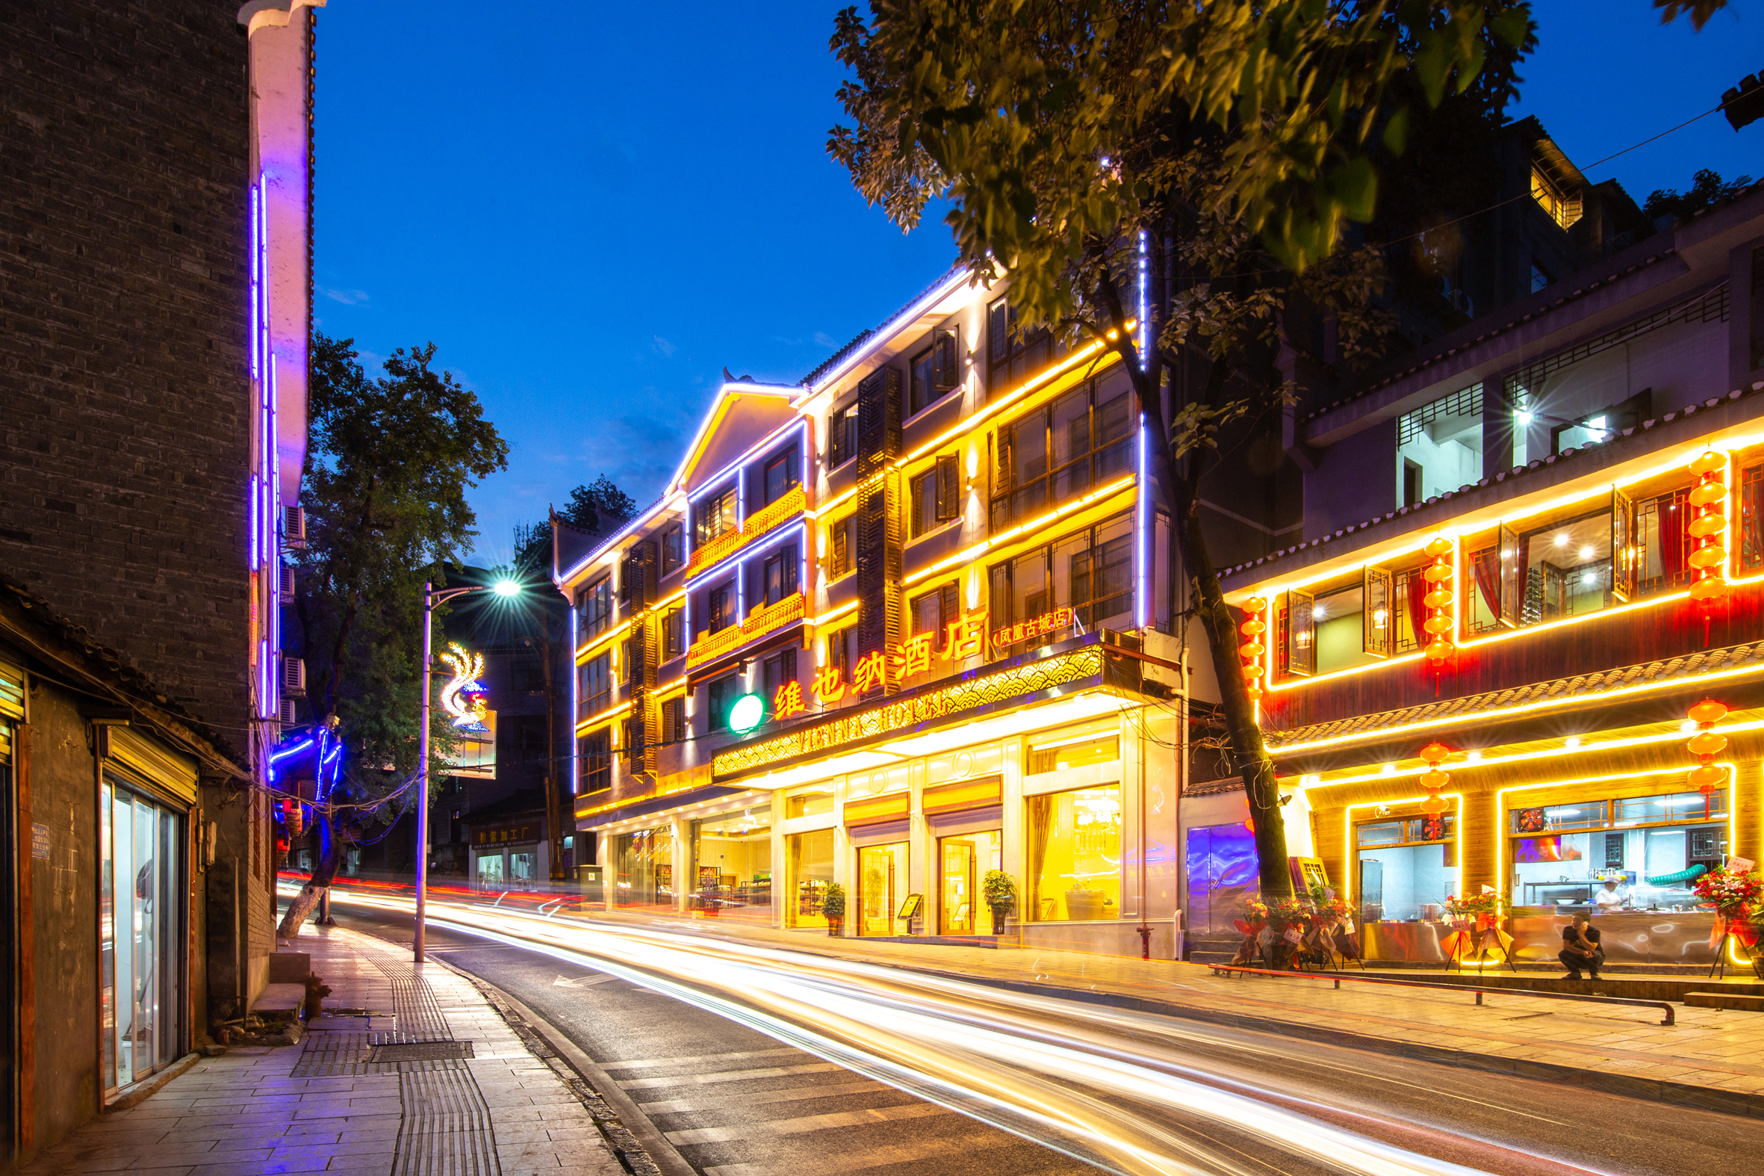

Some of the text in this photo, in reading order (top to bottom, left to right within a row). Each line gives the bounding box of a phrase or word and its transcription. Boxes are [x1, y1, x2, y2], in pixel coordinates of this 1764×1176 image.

[773, 611, 990, 721] 维也纳酒店
[797, 690, 948, 751] VIENNA HOTEL
